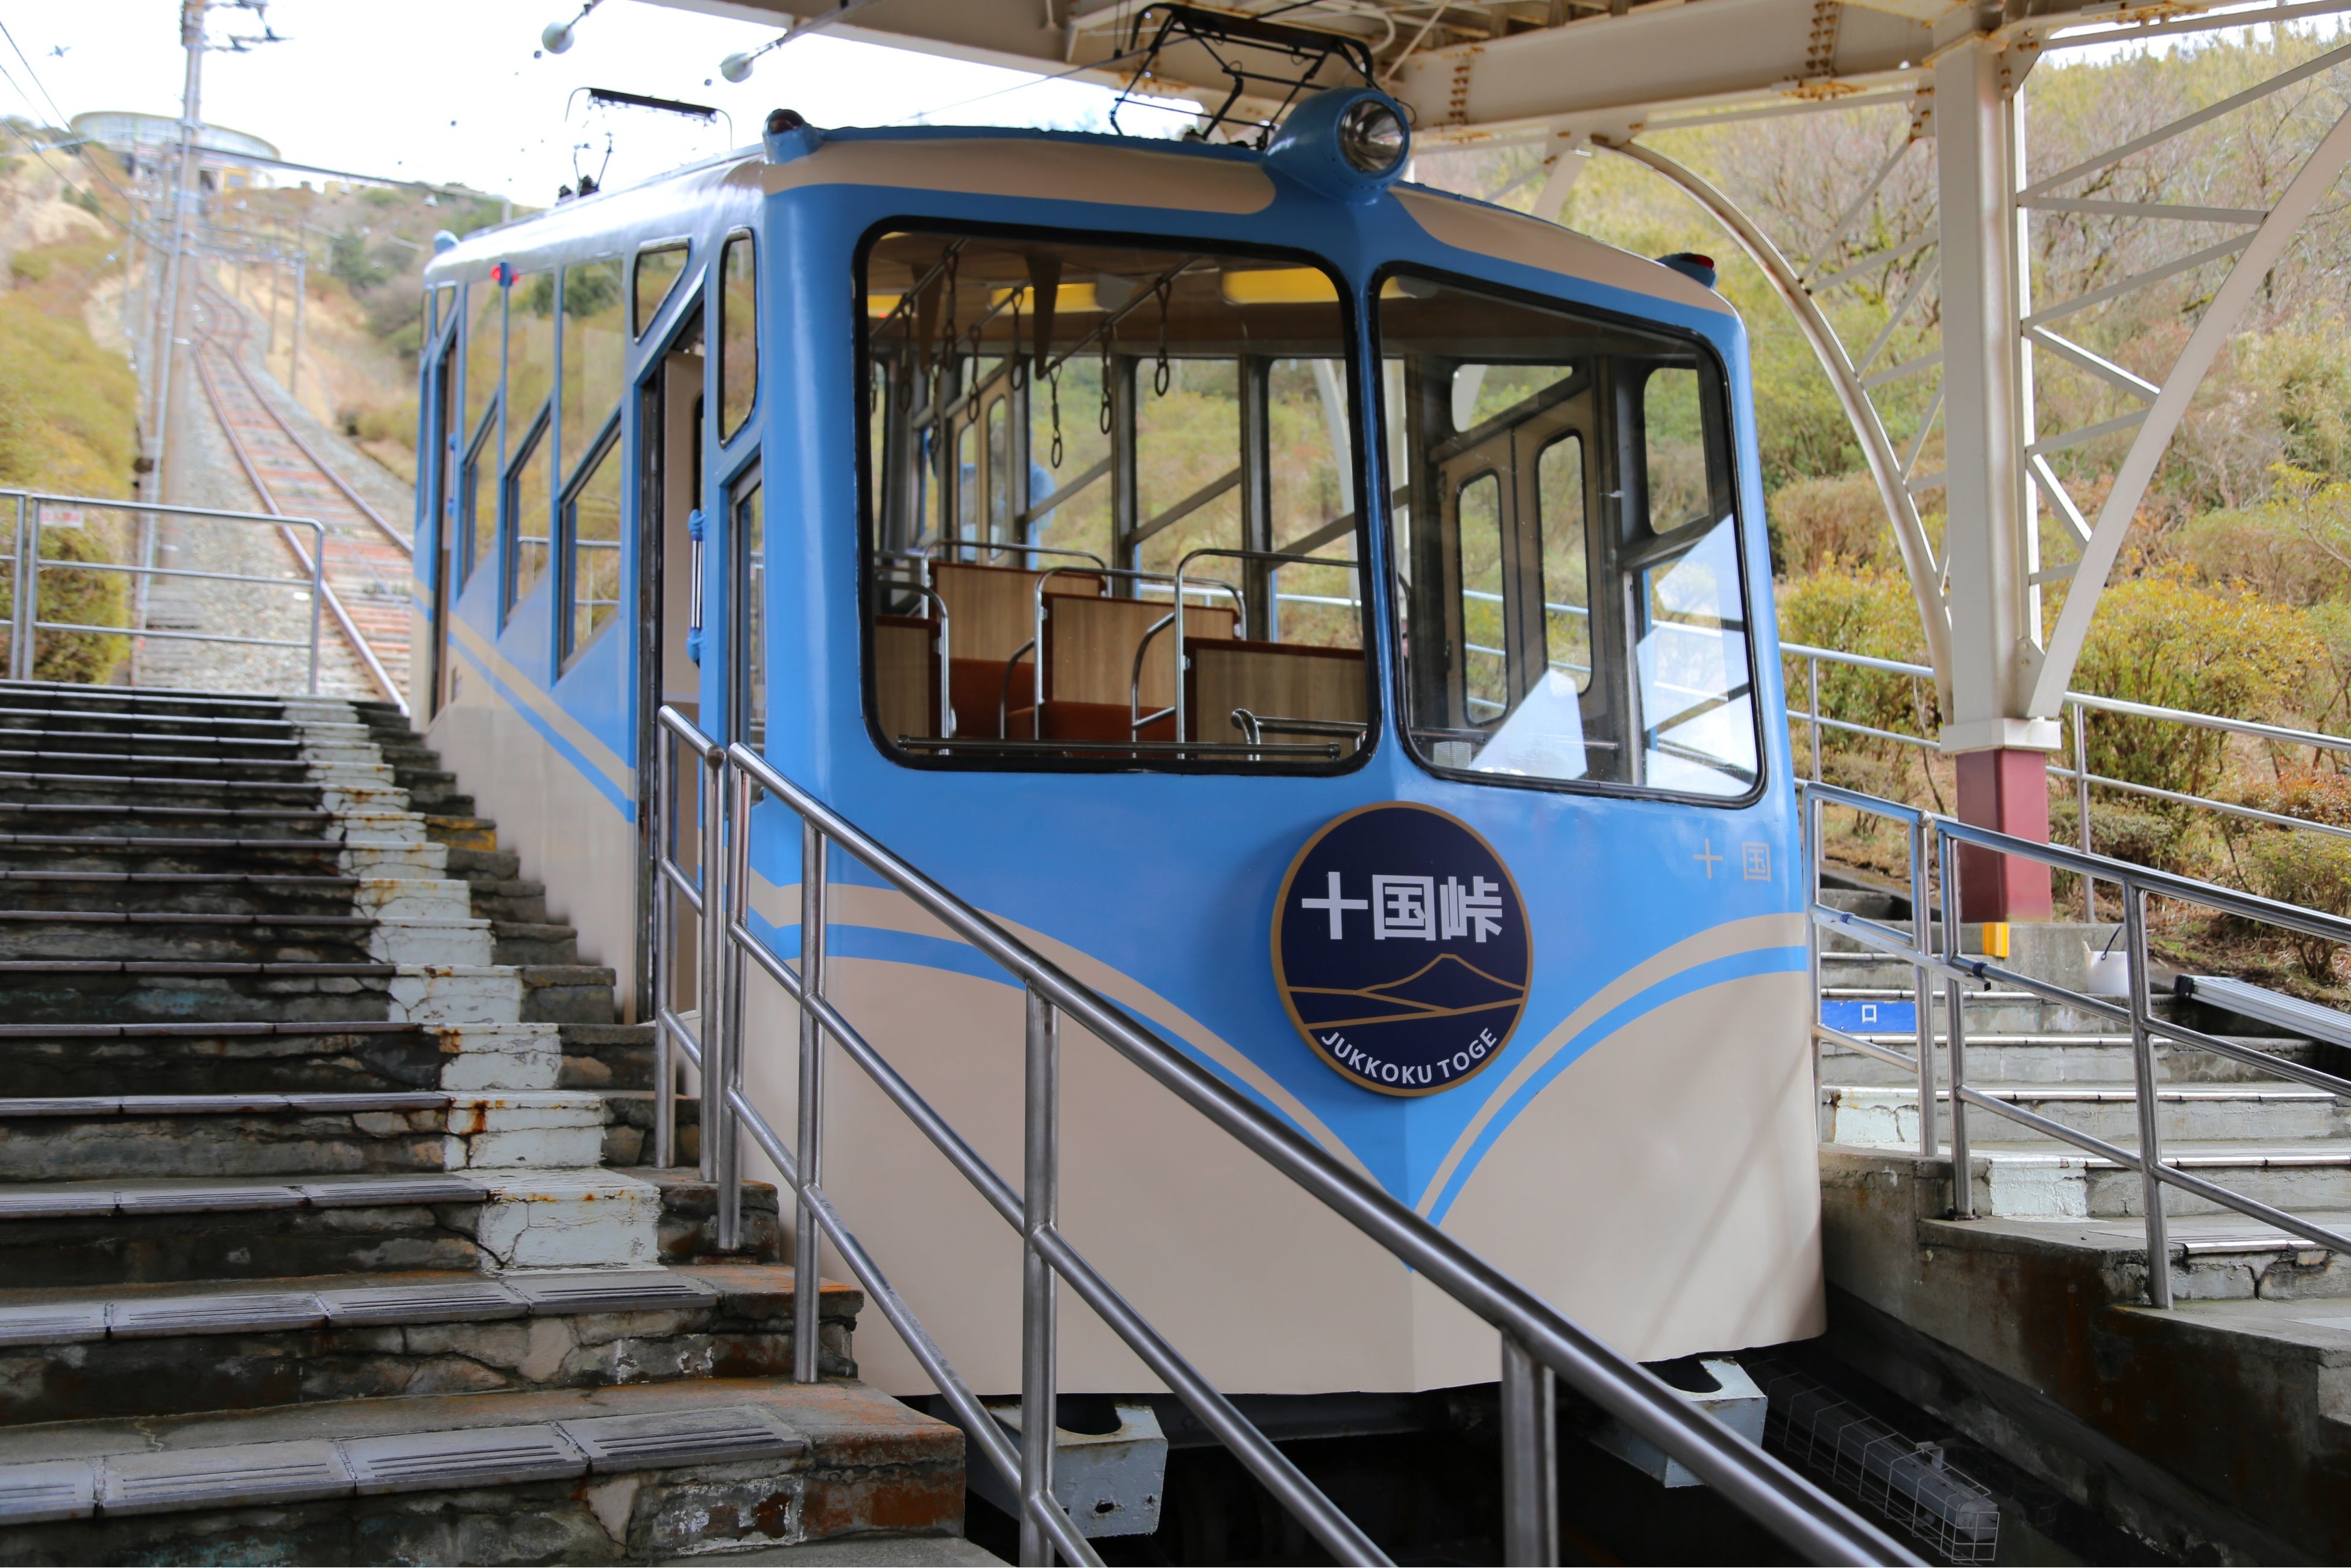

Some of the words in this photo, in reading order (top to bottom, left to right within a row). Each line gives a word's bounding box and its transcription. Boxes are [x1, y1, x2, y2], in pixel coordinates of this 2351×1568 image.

[1301, 871, 1503, 943] 十国峠
[1321, 1031, 1432, 1085] JUKKOKU
[1437, 1027, 1497, 1079] TOGE
